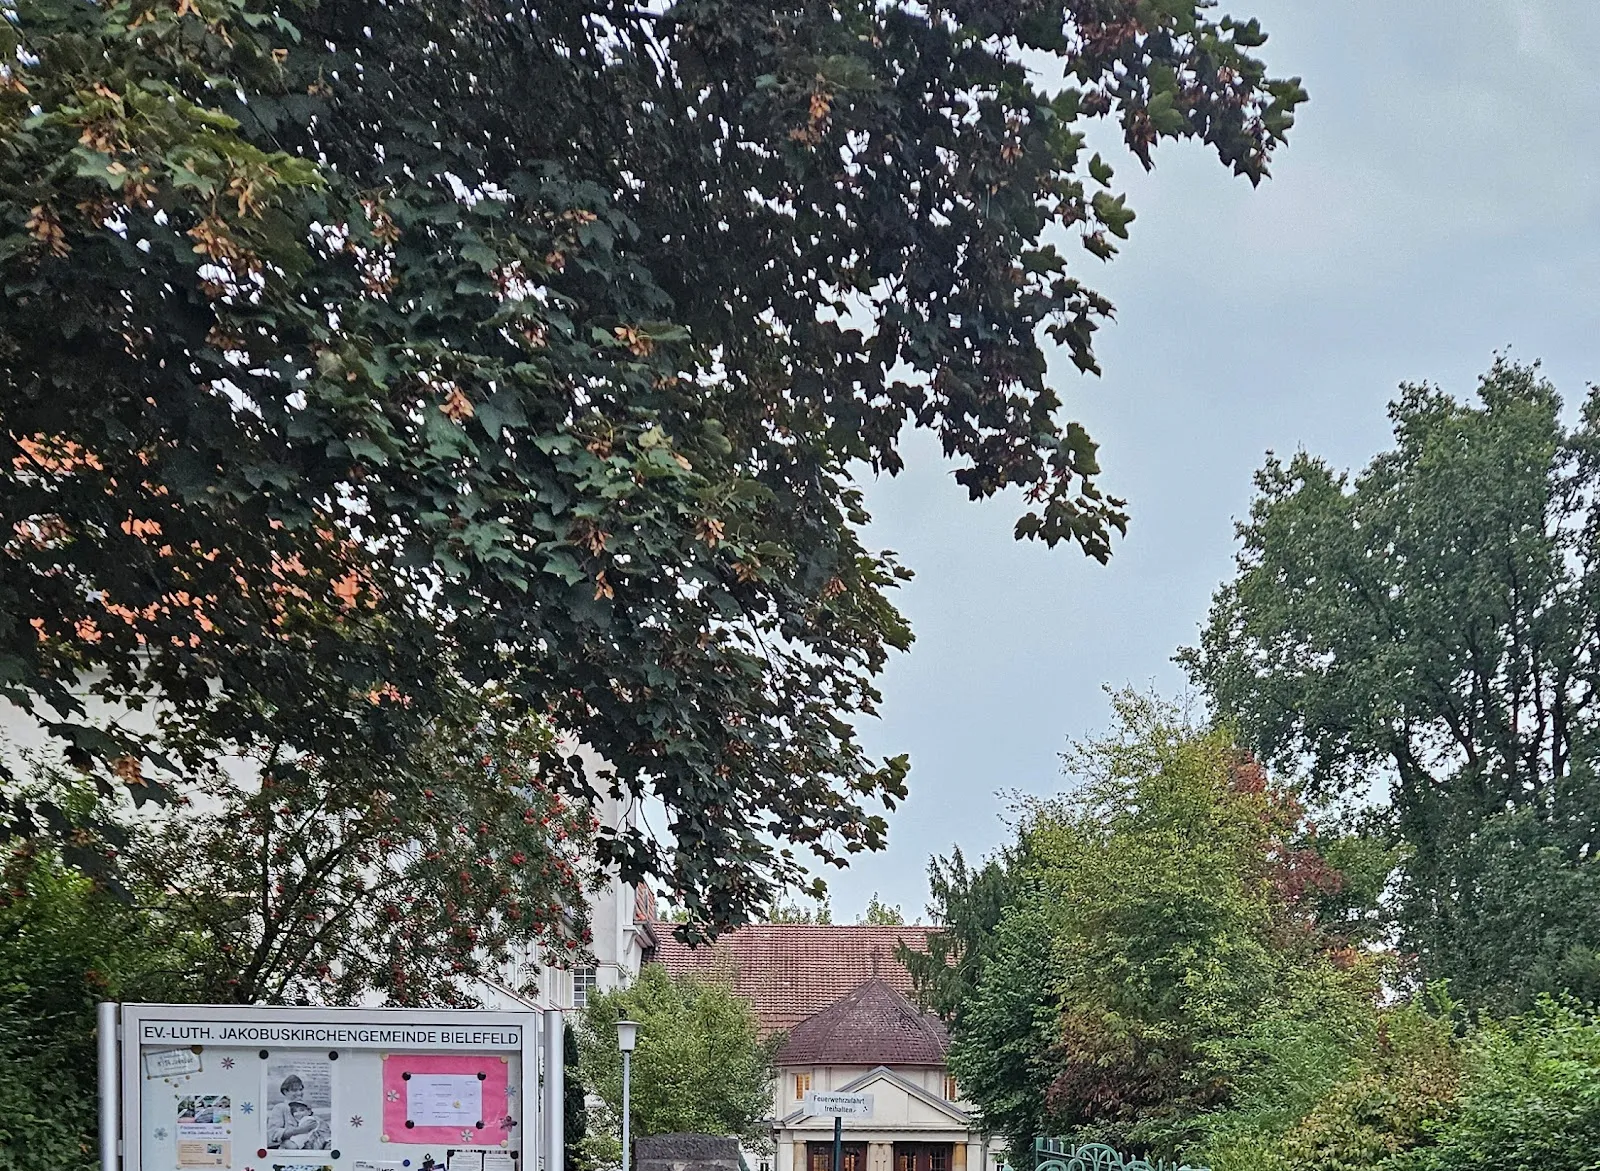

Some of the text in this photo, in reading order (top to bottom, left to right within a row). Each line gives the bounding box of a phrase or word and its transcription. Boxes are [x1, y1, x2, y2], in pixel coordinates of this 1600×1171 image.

[144, 1026, 518, 1045] EV.-LUTH. JAKOBUSKIRCHENGEMEINDE BIELEFELD
[813, 1094, 865, 1104] Feuerwehrzufahrt
